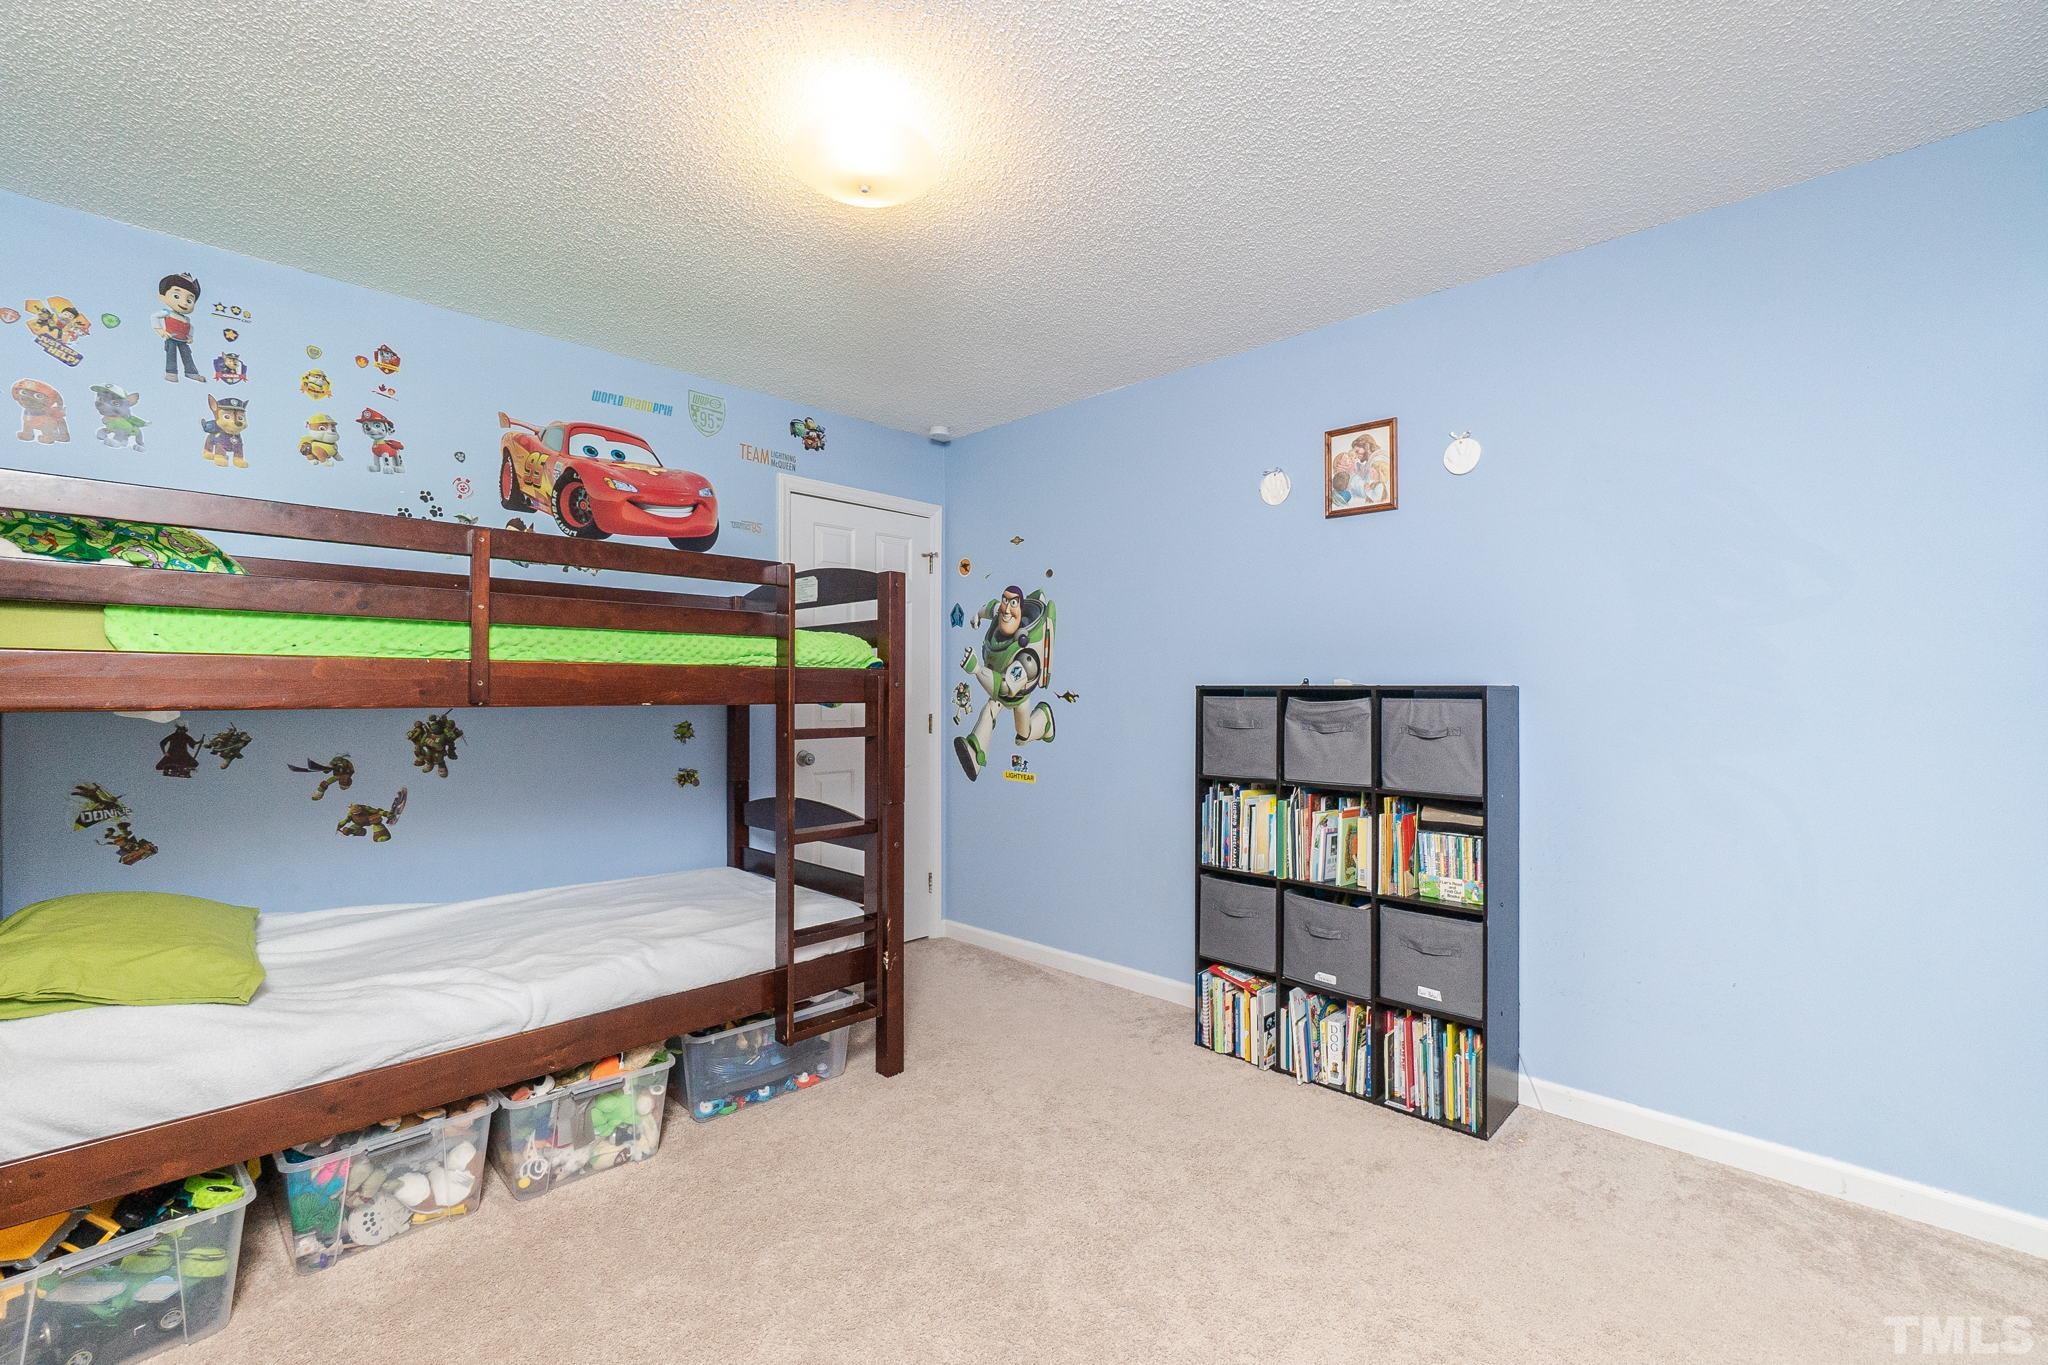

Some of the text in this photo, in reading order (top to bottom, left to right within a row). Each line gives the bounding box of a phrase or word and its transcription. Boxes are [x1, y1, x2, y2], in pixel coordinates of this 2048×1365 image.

[700, 411, 714, 429] 95
[740, 443, 770, 465] TEAM
[770, 450, 797, 464] LIGHTNING
[524, 451, 550, 489] 95
[770, 459, 797, 472] McQUEEN
[1005, 771, 1035, 781] LIGHTYEAR
[1330, 1024, 1339, 1052] DOG
